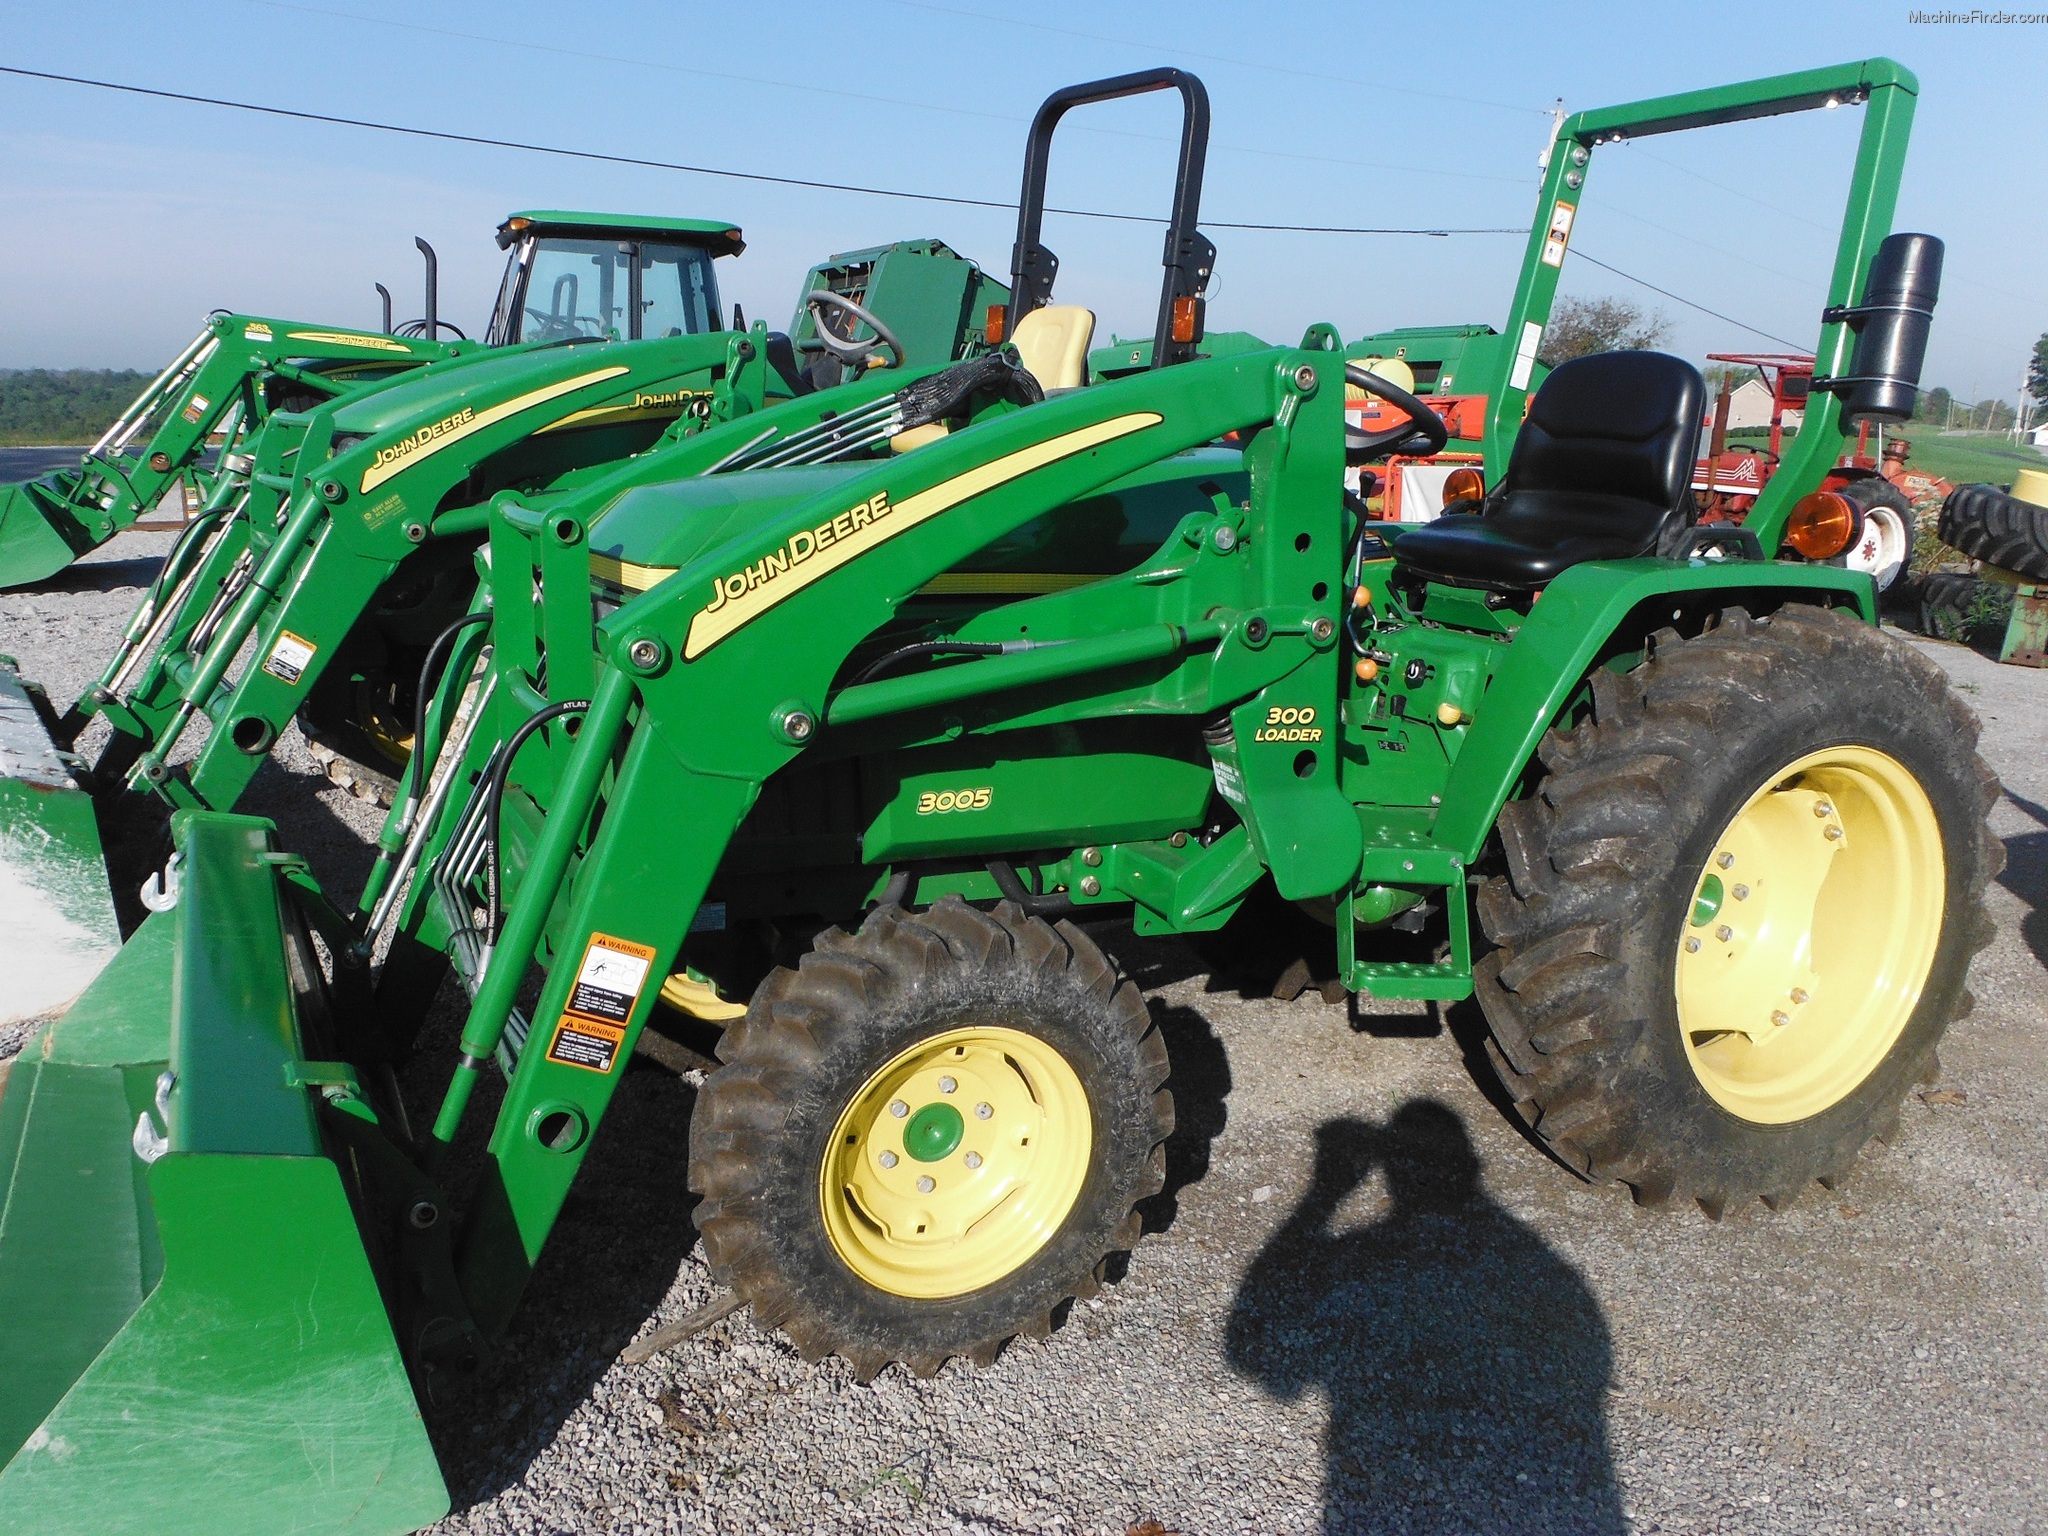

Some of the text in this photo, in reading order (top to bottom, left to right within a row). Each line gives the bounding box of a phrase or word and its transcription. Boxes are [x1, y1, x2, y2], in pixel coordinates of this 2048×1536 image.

[628, 393, 677, 409] JOHN
[372, 406, 476, 470] JOHN DEERE
[706, 490, 893, 614] JOHN DEERE
[563, 701, 587, 709] ATLAS
[1265, 706, 1316, 725] 300
[1254, 728, 1323, 742] LOADER
[917, 788, 992, 814] 3005
[608, 940, 647, 957] WARNING
[577, 1022, 617, 1038] WARNING
